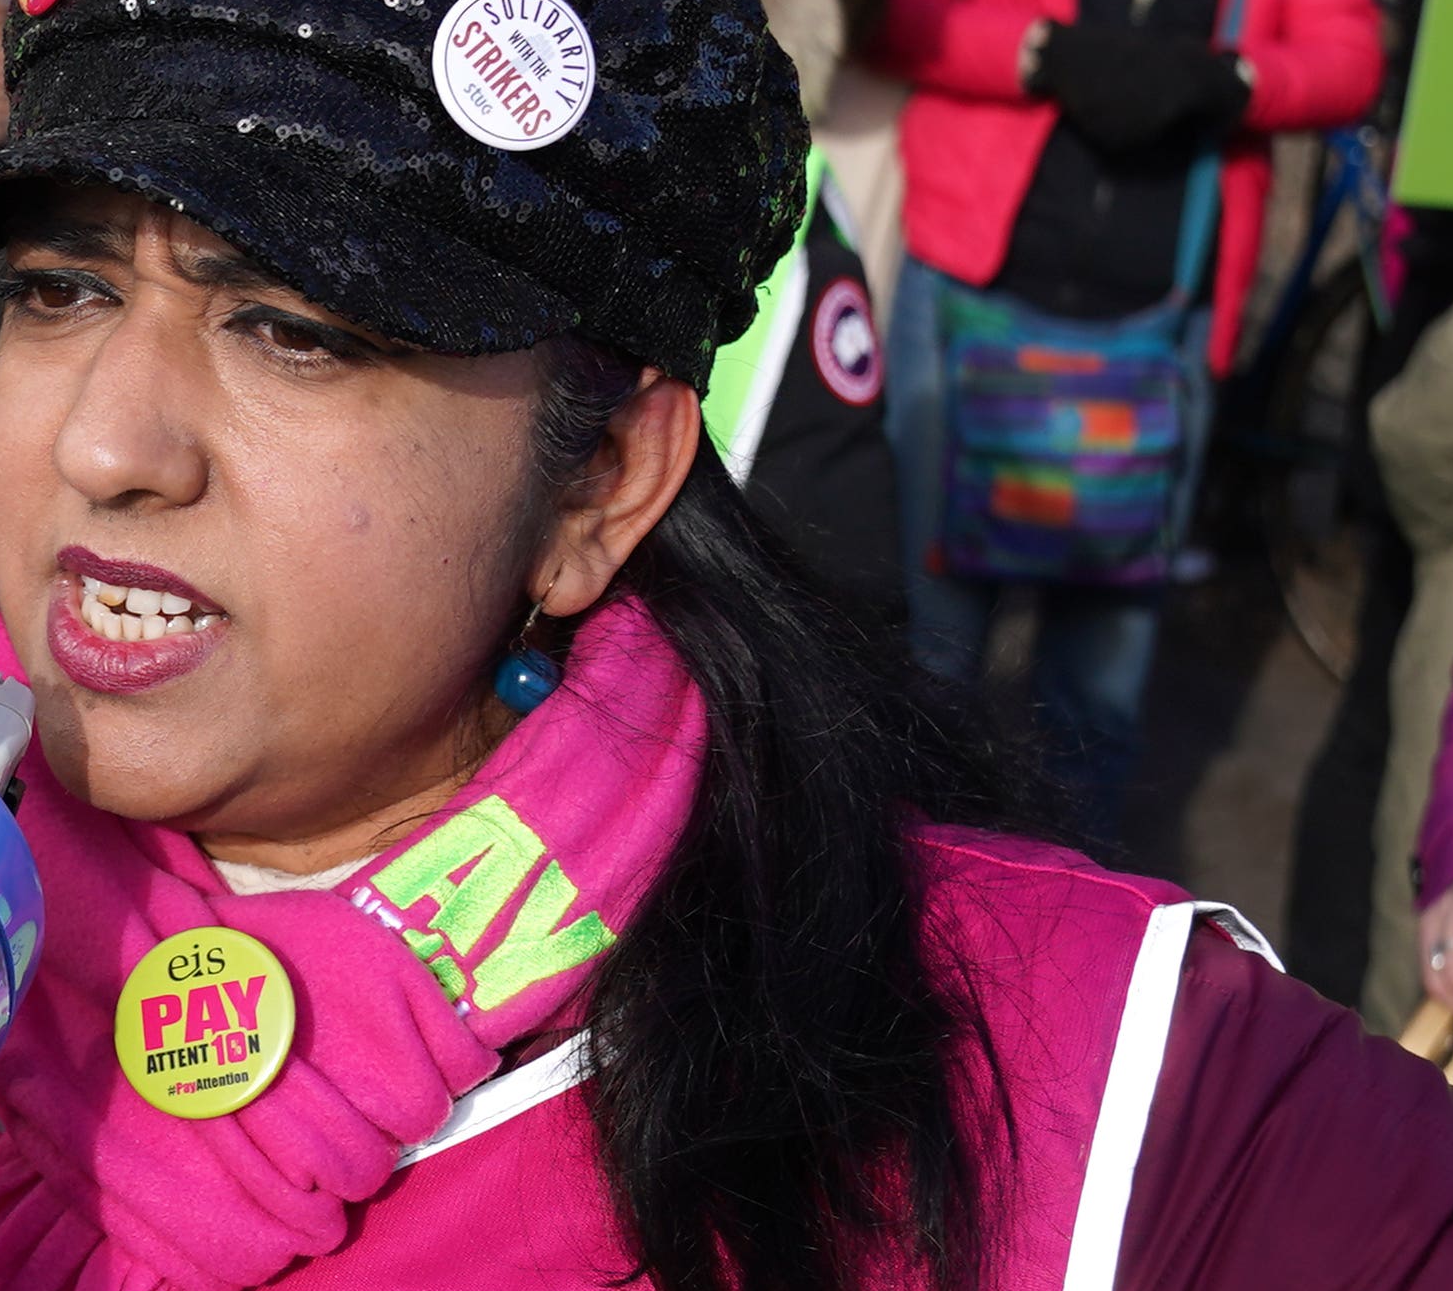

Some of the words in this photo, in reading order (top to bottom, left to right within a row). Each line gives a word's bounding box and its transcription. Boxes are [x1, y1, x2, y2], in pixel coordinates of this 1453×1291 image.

[452, 21, 551, 136] STRIKERS
[508, 29, 536, 62] WITH
[528, 55, 552, 81] THE
[371, 795, 618, 1010] AY
[167, 944, 226, 982] eis
[140, 975, 267, 1052] PAY
[167, 1071, 249, 1096] #PayAttention
